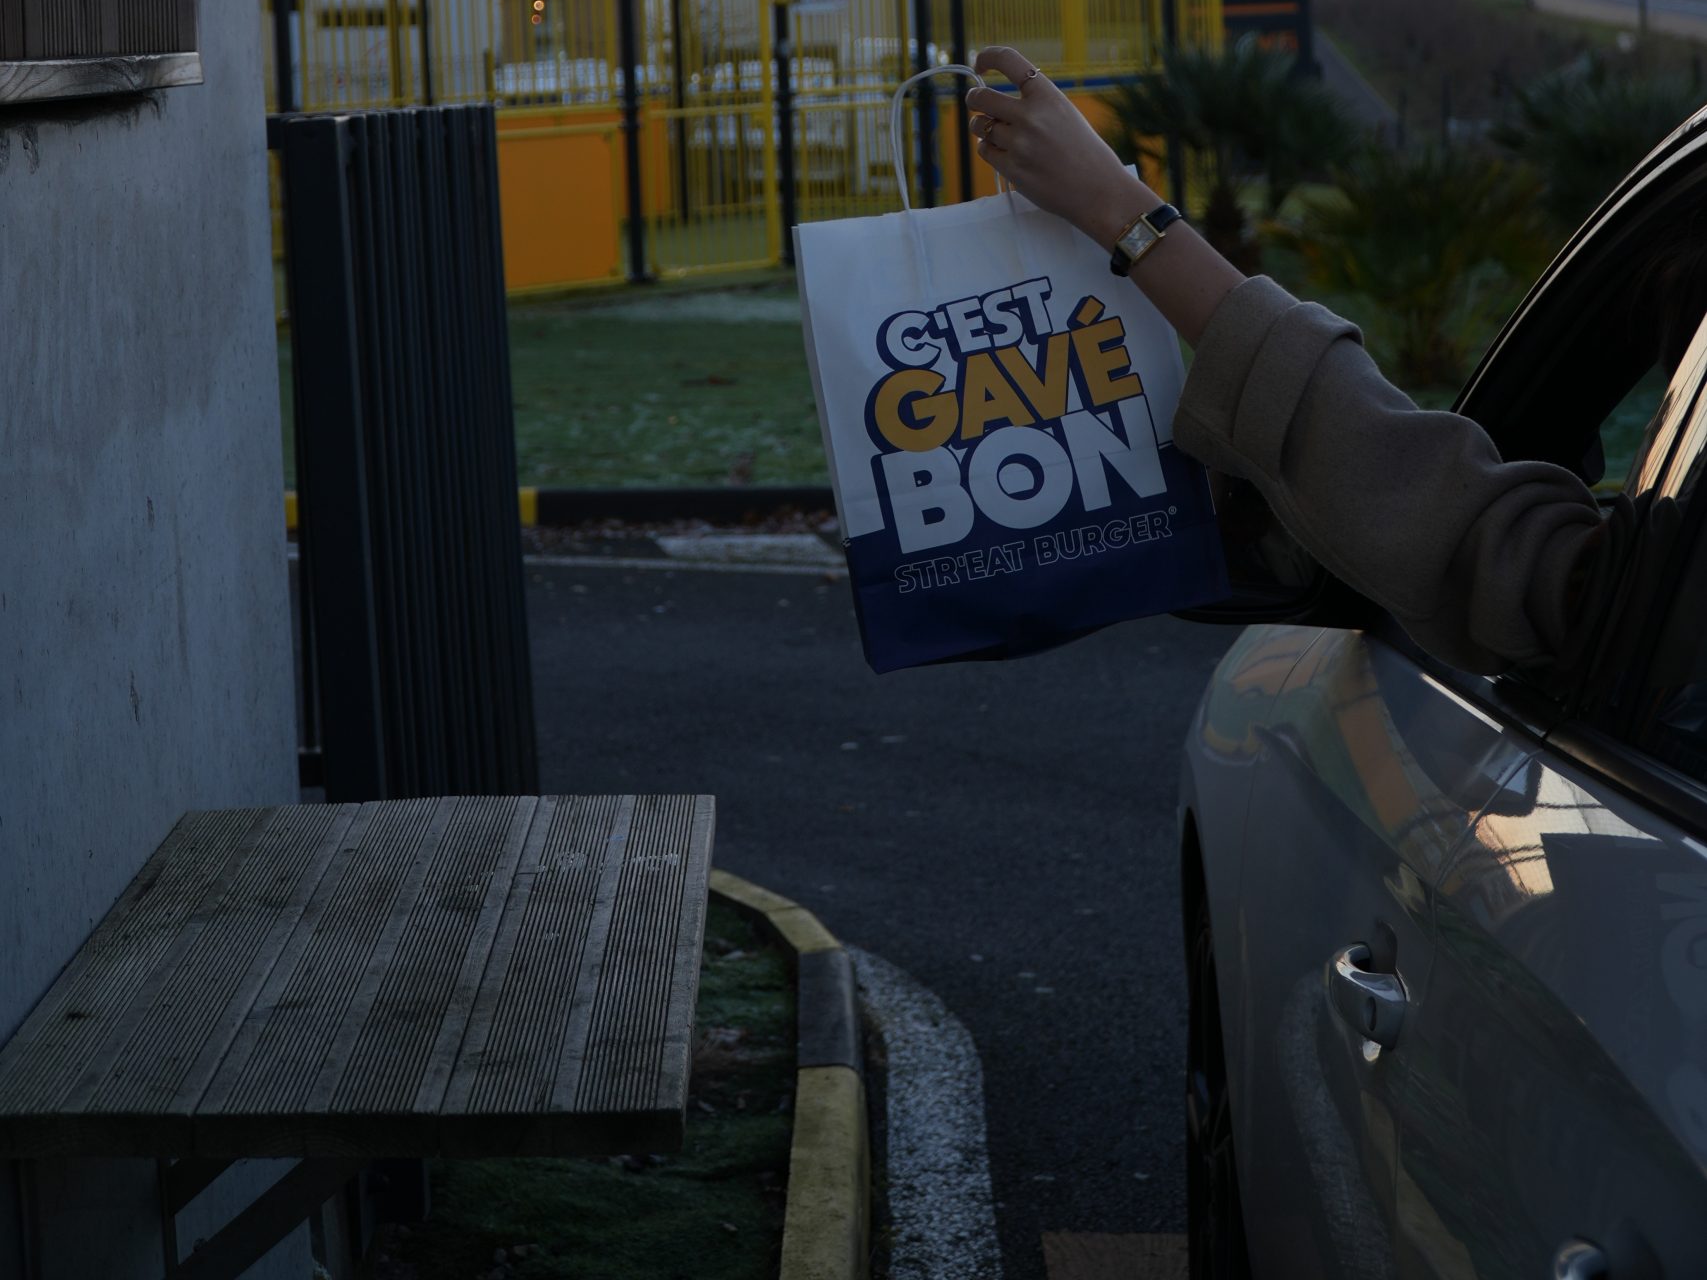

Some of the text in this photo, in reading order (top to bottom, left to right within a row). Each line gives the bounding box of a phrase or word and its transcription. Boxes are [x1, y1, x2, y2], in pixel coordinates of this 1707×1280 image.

[866, 295, 1145, 453] GAVÉ
[877, 276, 1052, 370] C'EST
[873, 395, 1168, 554] BON
[894, 541, 1026, 594] STR'EAT
